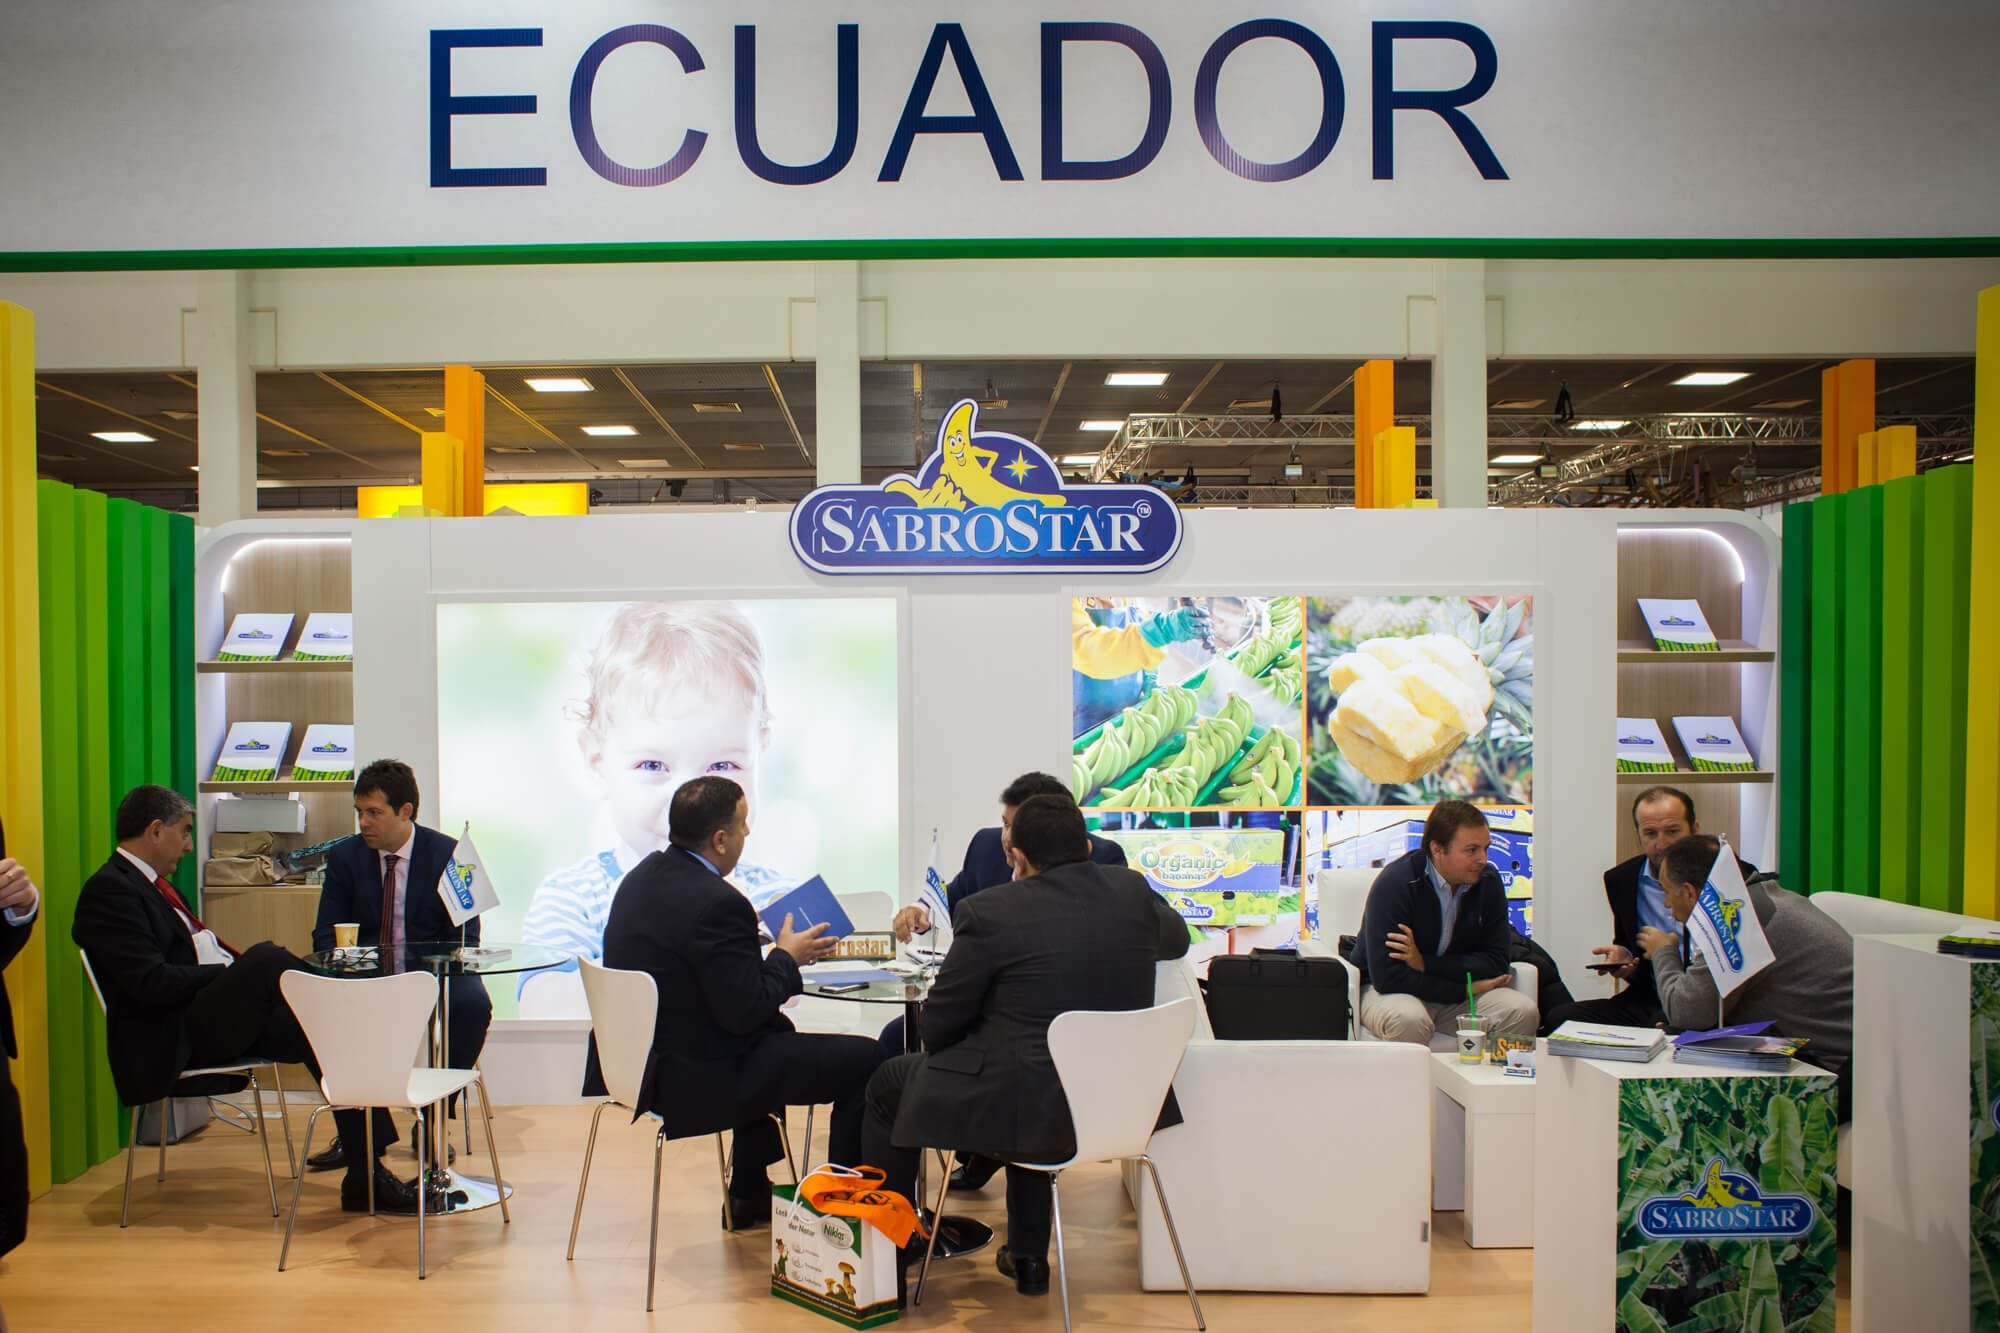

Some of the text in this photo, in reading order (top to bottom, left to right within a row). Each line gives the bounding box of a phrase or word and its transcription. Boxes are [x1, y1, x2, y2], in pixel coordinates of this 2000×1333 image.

[430, 18, 1511, 189] ECUADOR
[821, 503, 1145, 554] SABROSTAR
[1141, 848, 1228, 872] Organic
[1651, 1205, 1799, 1229] SABROSTAR
[823, 1223, 845, 1241] Niklas
